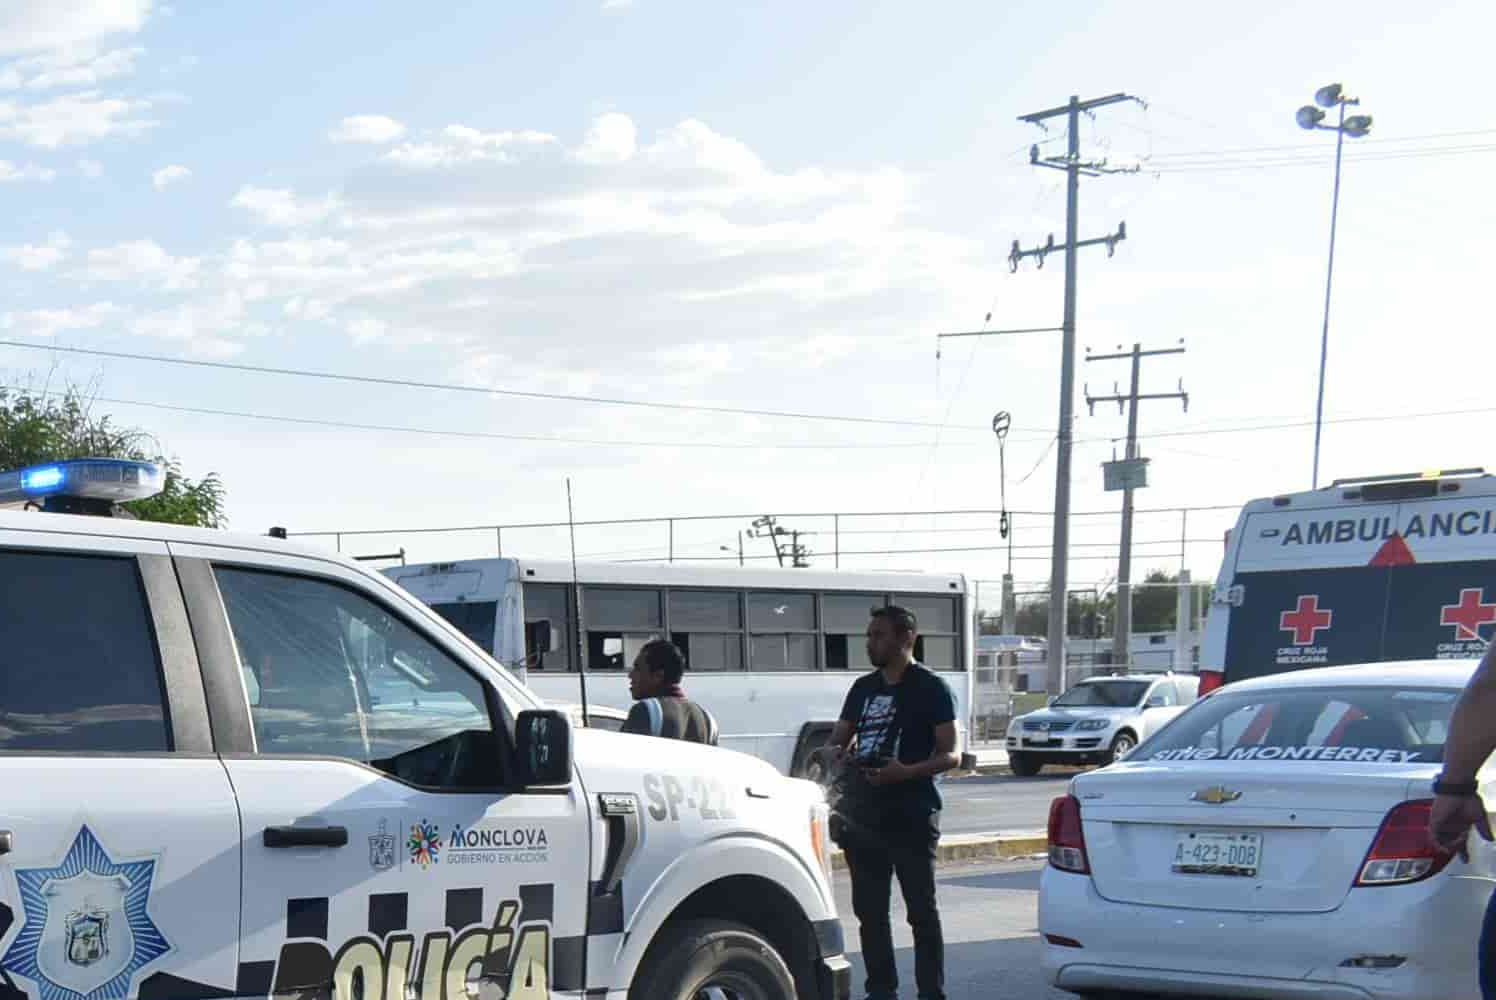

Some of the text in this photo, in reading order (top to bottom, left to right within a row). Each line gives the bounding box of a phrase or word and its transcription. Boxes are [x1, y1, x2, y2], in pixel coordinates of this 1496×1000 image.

[1281, 509, 1496, 546] AMBULANCI
[1226, 746, 1422, 763] MONTERREY
[449, 828, 549, 848] MONCLOVA
[447, 853, 496, 864] GOBIERNO
[498, 853, 512, 863] EN
